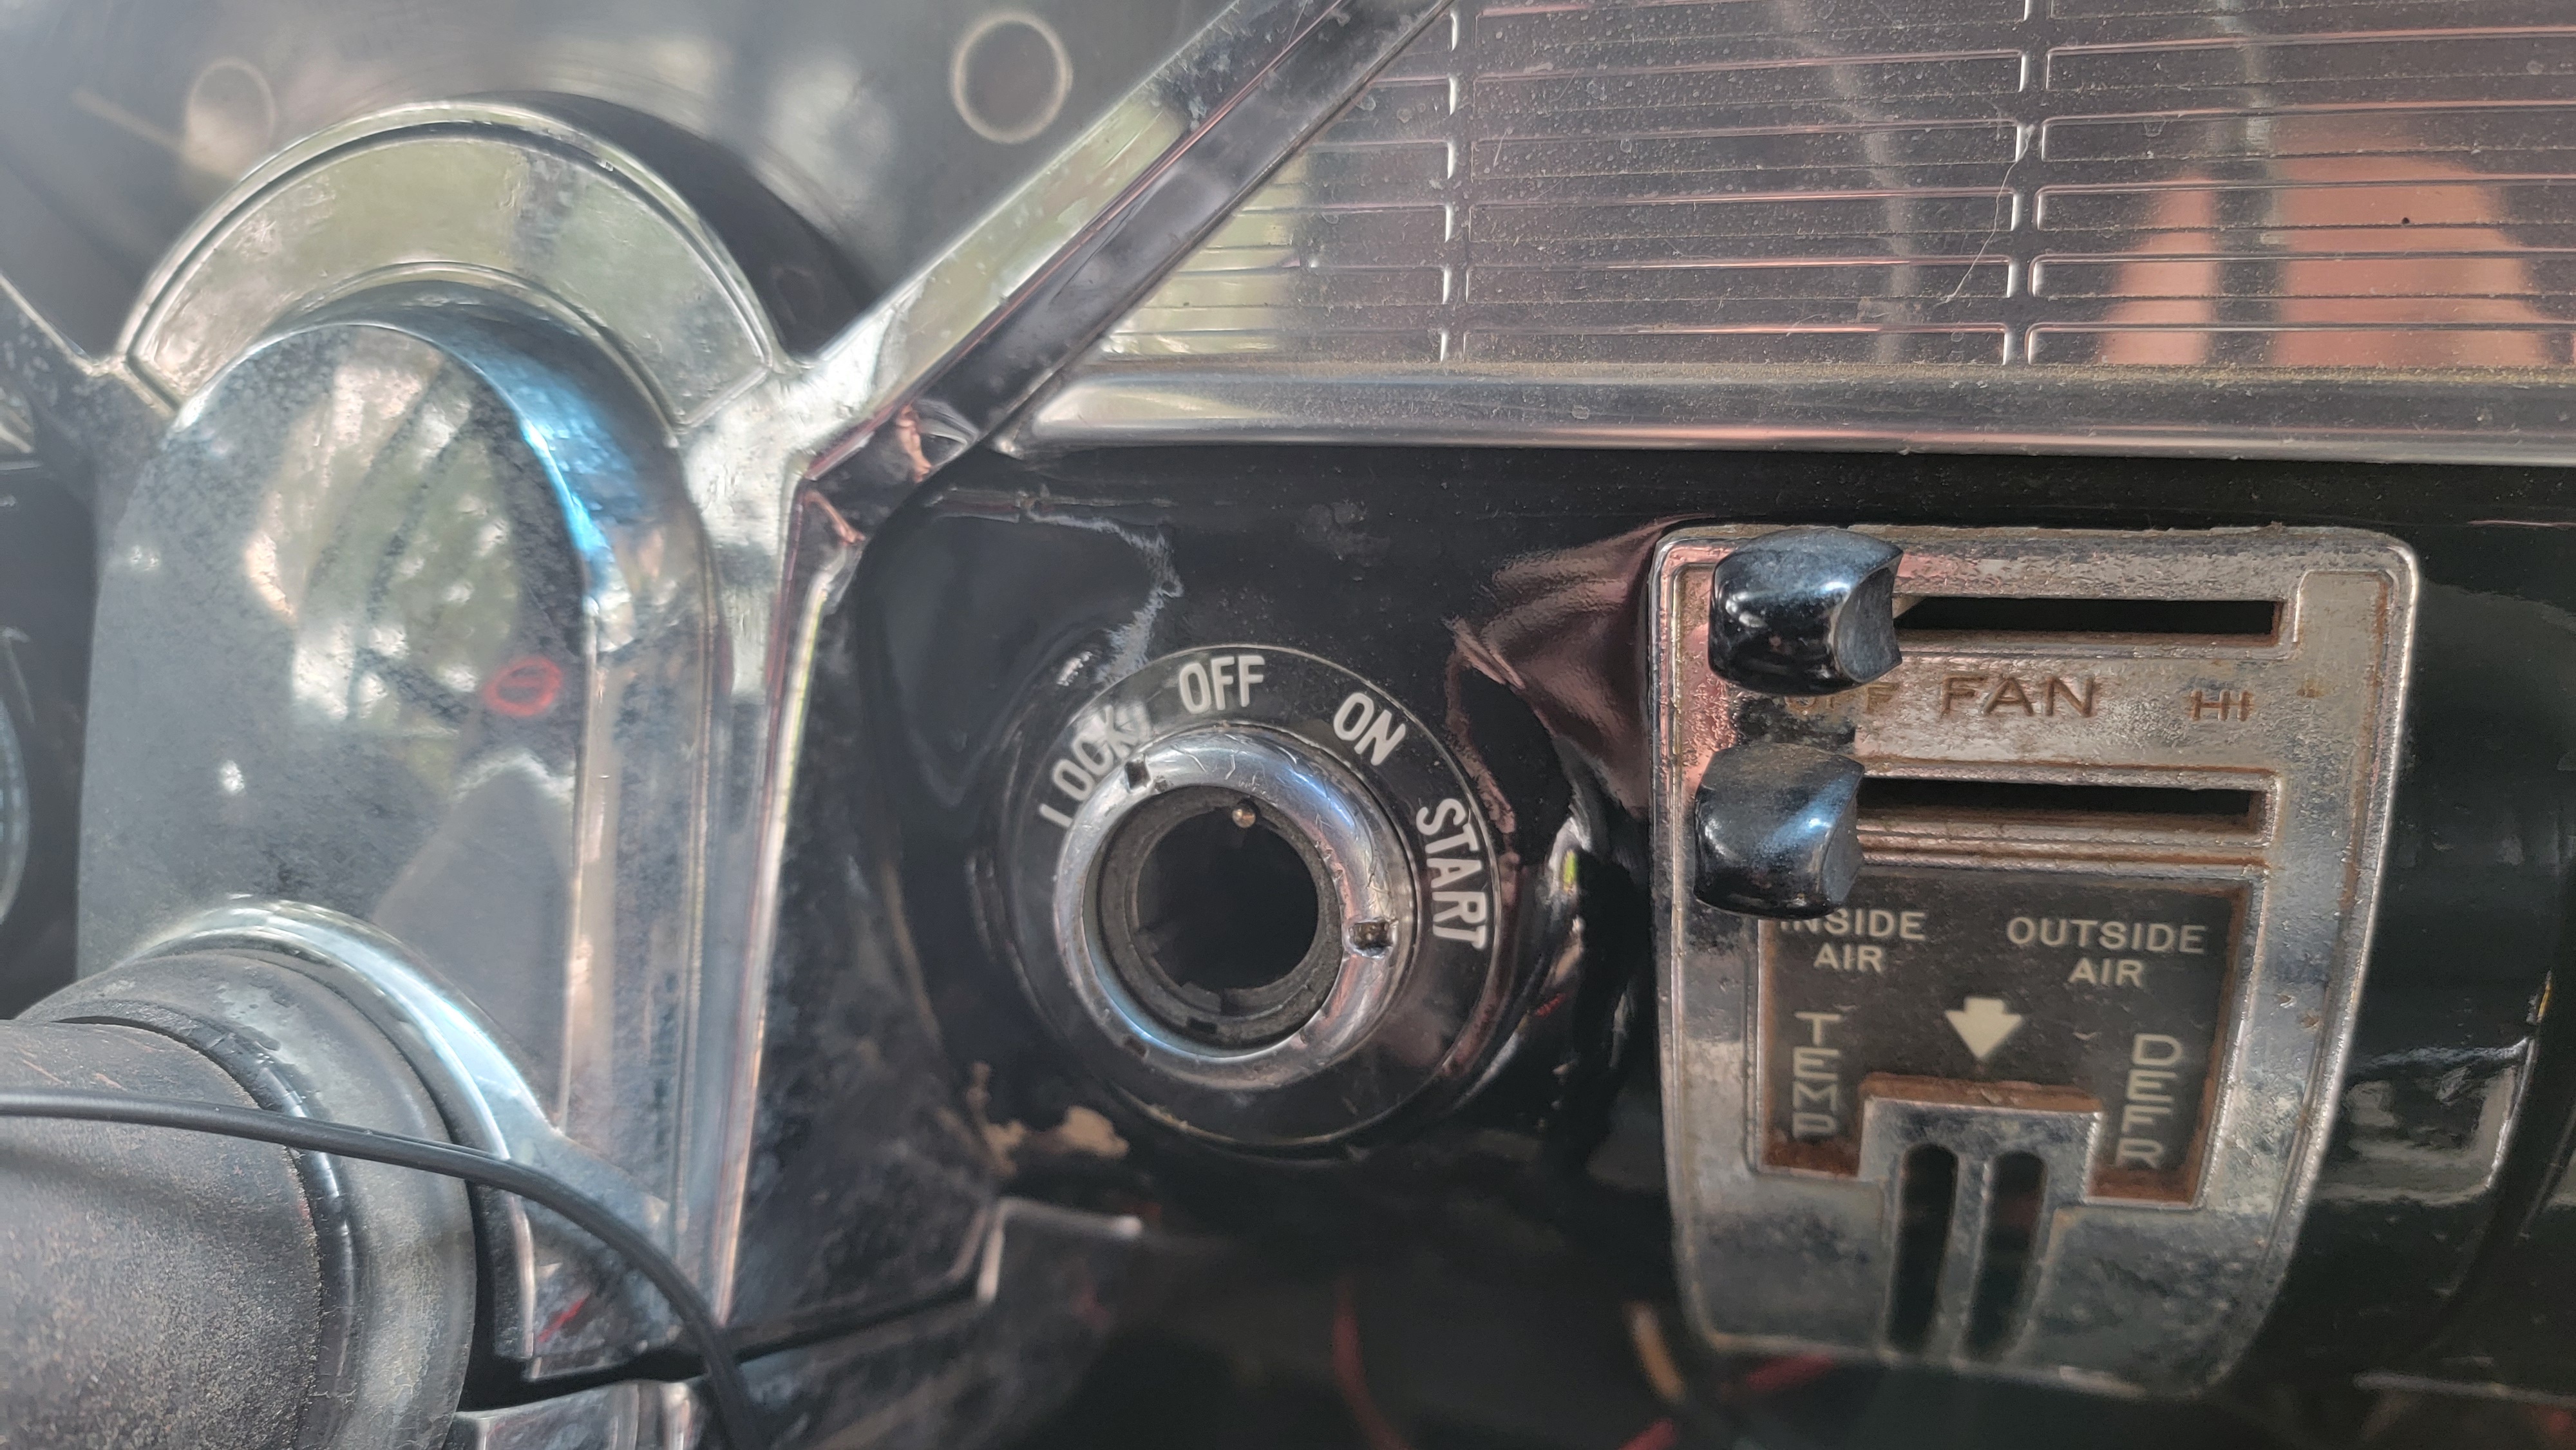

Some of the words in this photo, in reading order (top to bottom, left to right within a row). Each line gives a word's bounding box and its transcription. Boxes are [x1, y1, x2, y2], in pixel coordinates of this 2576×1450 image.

[1178, 654, 1265, 715] OFF
[1939, 672, 2096, 719] FAN
[2190, 688, 2249, 722] HI
[1332, 692, 1408, 766] ON
[1416, 797, 1488, 951] START
[1813, 942, 1882, 974] AIR
[2006, 916, 2208, 956] OUTSIDE
[2067, 957, 2144, 988] AIR
[1792, 1011, 1843, 1140] TEMP
[2115, 1032, 2185, 1169] DEFR
